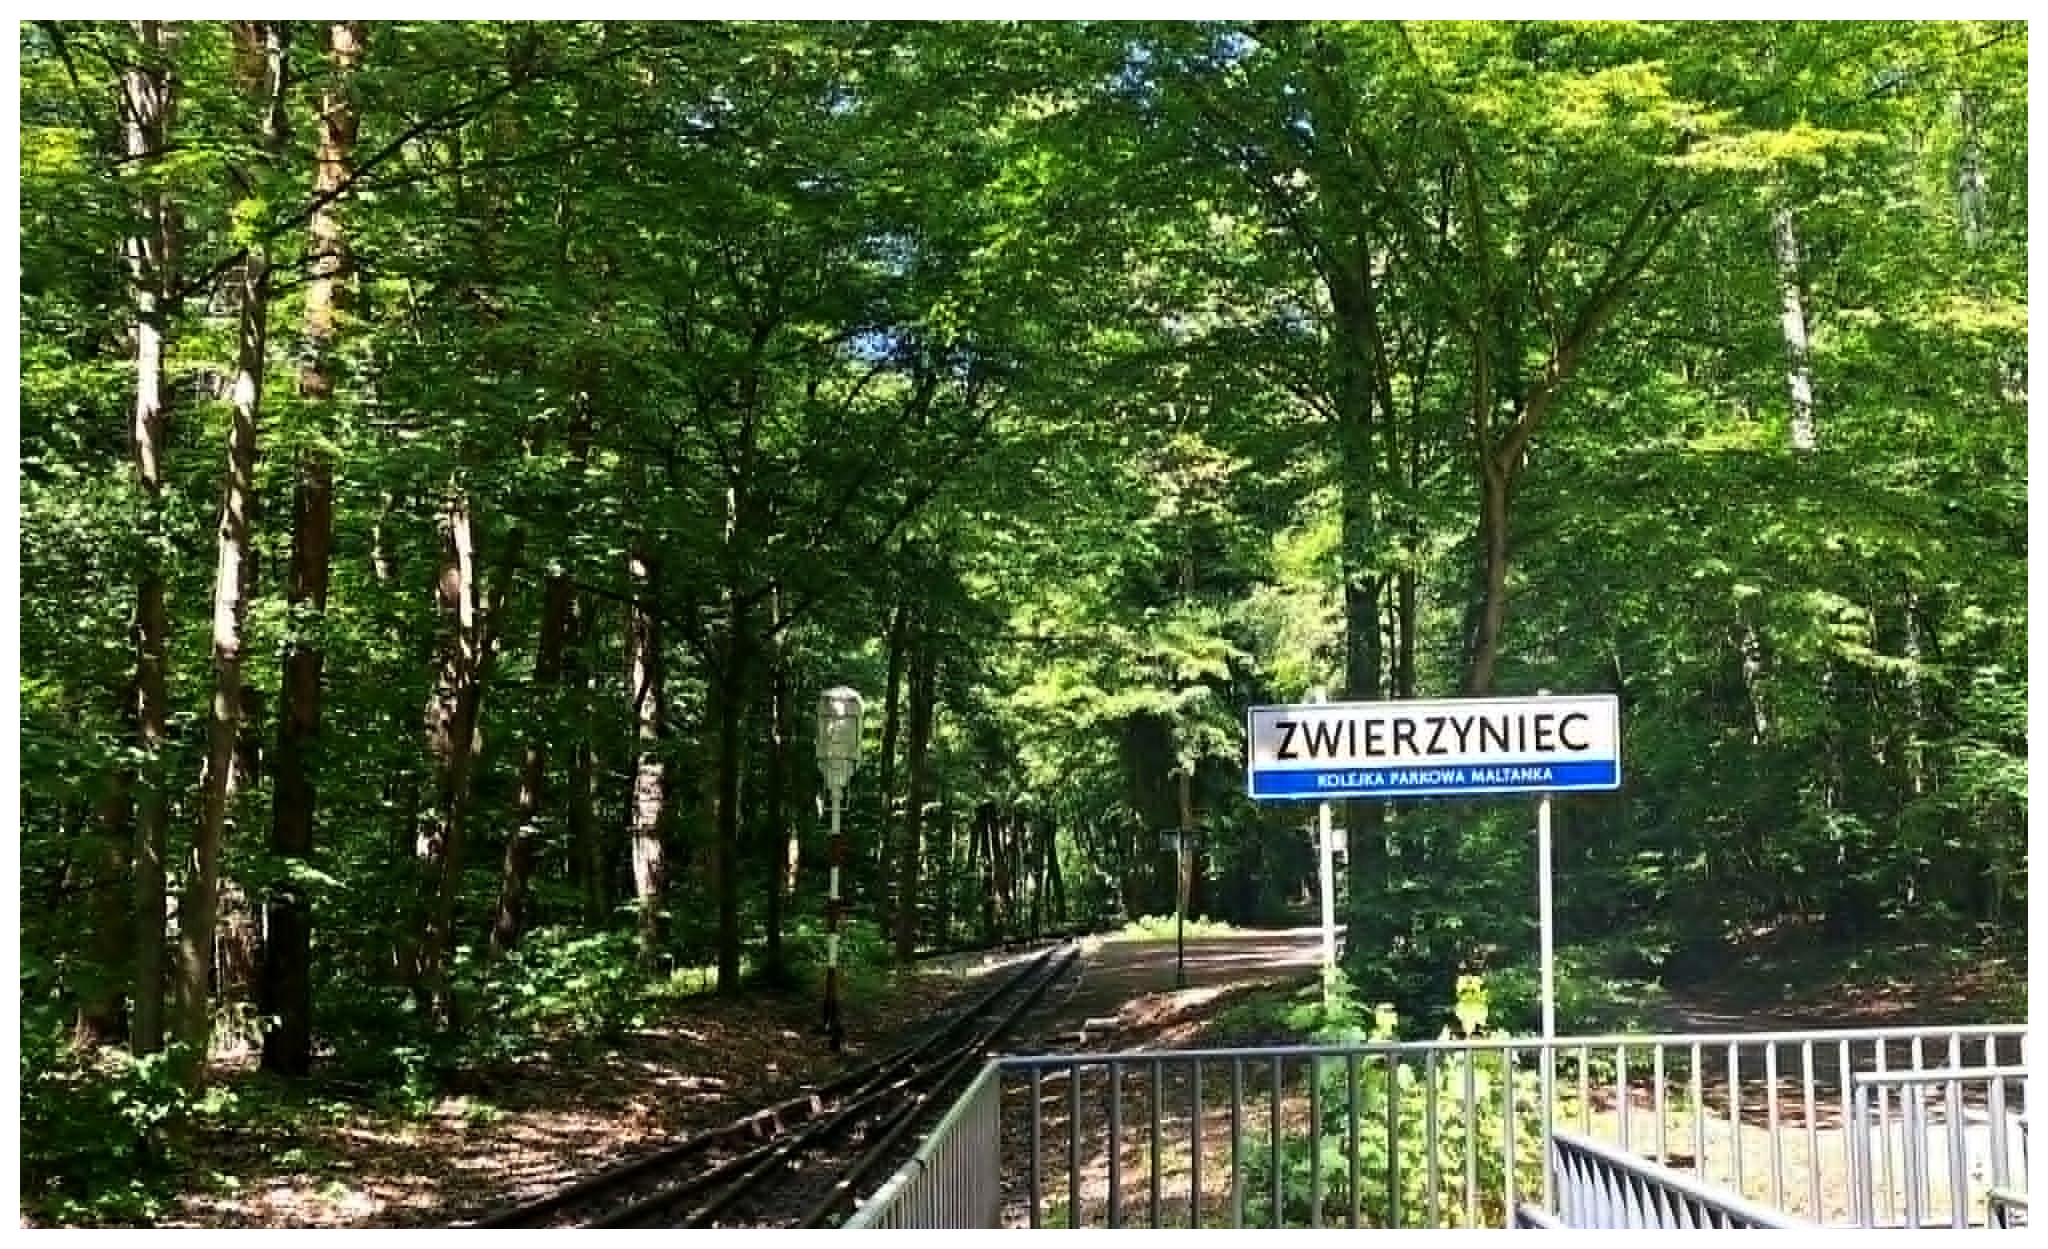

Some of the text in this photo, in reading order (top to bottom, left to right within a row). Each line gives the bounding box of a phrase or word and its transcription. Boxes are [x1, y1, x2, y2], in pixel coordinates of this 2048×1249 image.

[1274, 712, 1590, 760] ZWIERZYNIEC
[1317, 767, 1553, 788] KOLEJKA PARKOWA MALTANKA
